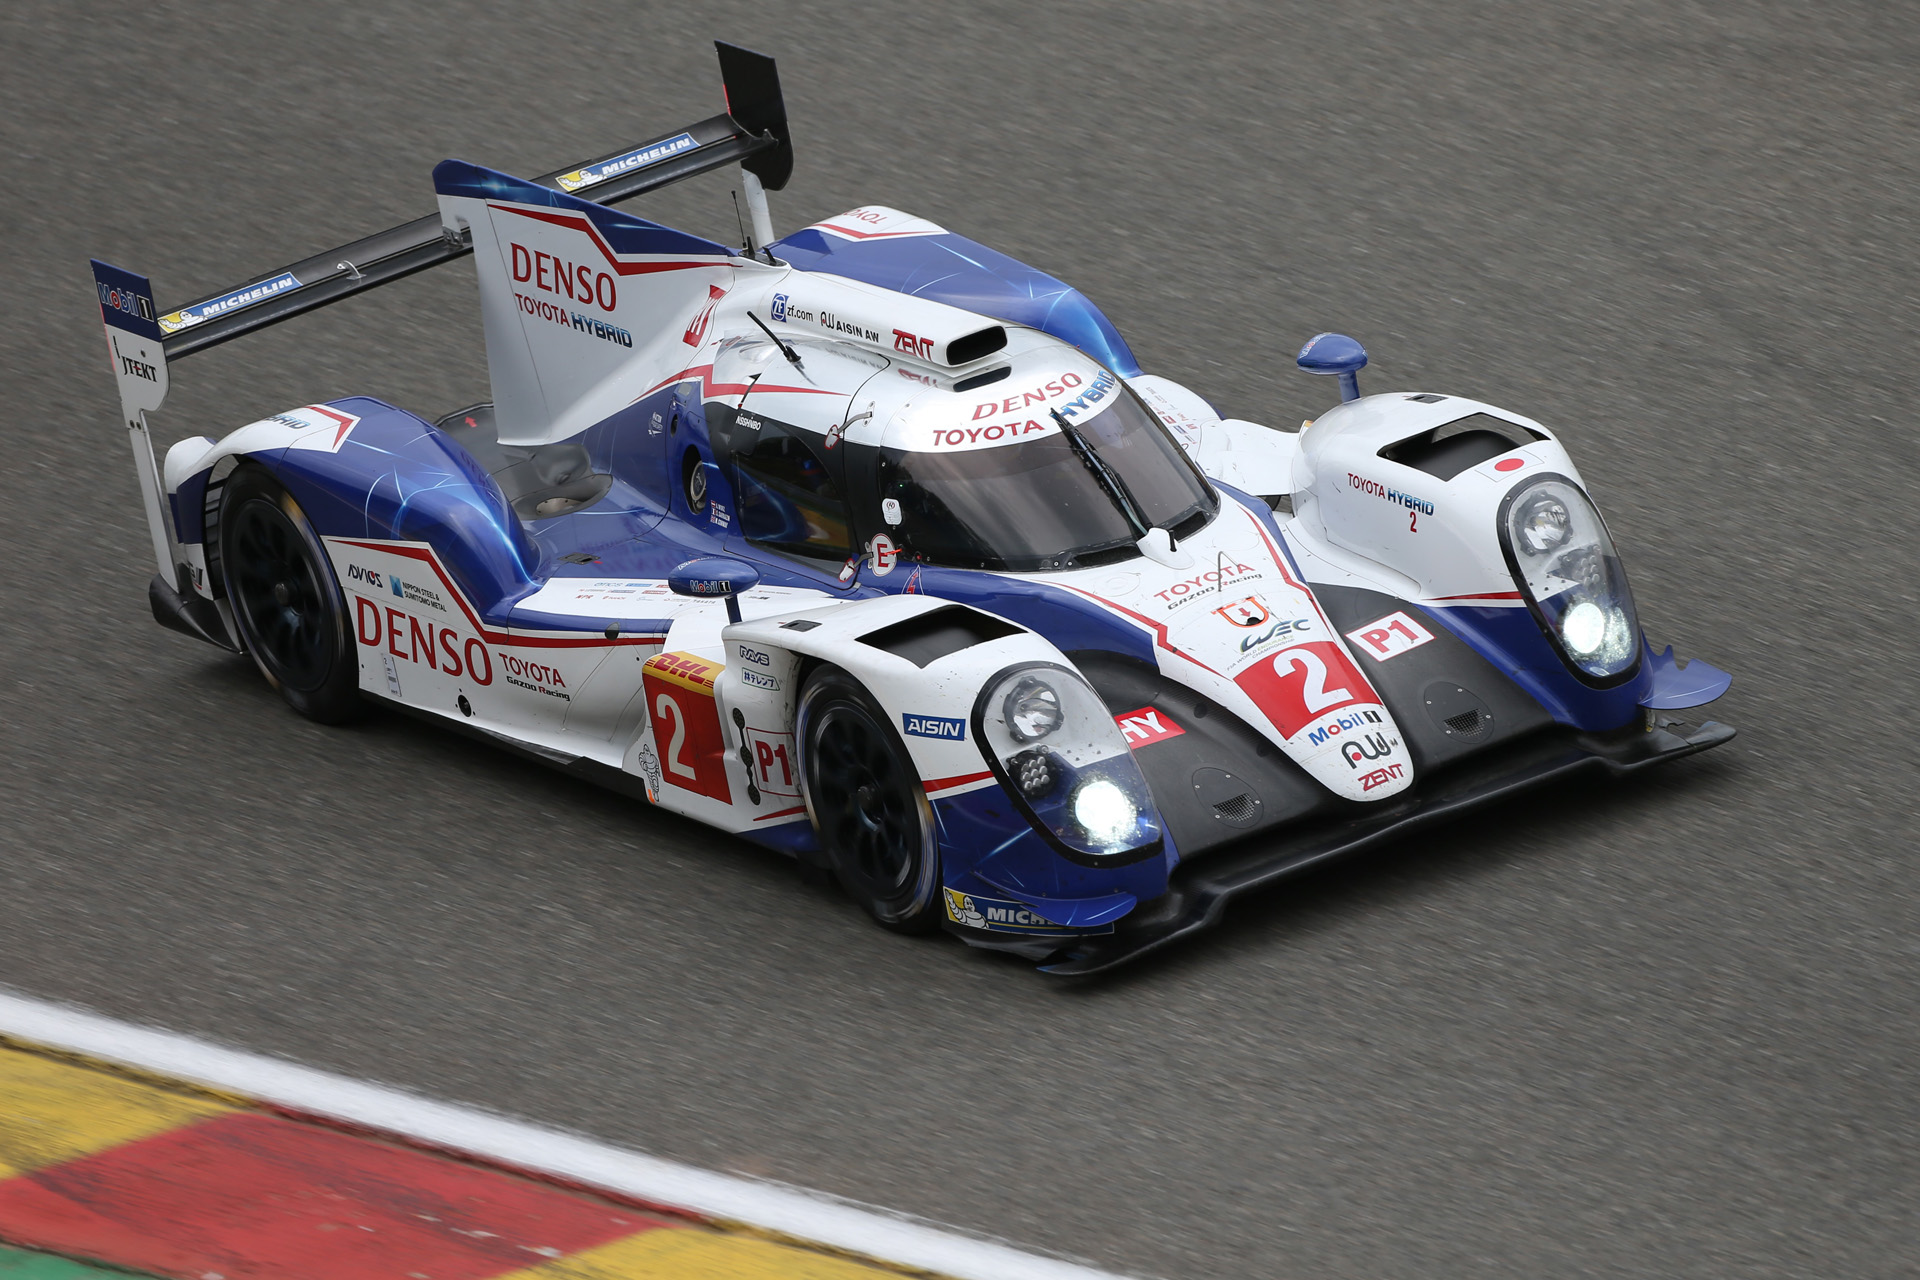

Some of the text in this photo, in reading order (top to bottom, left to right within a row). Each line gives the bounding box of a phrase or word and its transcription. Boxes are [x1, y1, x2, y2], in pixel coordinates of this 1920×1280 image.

[602, 137, 691, 175] MICHELIN
[510, 242, 616, 312] DENSO
[97, 281, 154, 322] Mobil 1
[202, 277, 293, 316] MICHELIN
[514, 292, 633, 348] TOYOTA HYBRID
[787, 305, 814, 322] zf.com
[836, 321, 863, 338] AISIN
[865, 330, 879, 343] AW
[892, 329, 934, 362] ZENT
[121, 356, 157, 383] JTEKT
[972, 372, 1082, 421] DENSO
[735, 413, 761, 431] NISSHINBO
[933, 420, 1045, 446] TOYOTA
[1347, 472, 1434, 516] TOYOTA HYBRID
[1409, 511, 1418, 533] 2
[877, 543, 890, 568] E
[402, 581, 421, 595] NIPPON
[421, 588, 436, 600] STEEL
[690, 579, 732, 594] Mobil 1
[1153, 563, 1256, 602] TOYOTA
[1167, 586, 1215, 610] GAZOO
[404, 591, 447, 612] SUMITOMO METAL
[355, 595, 493, 686] DENSO
[1240, 619, 1310, 652] WEC
[1360, 619, 1419, 653] P1
[498, 652, 566, 688] TOYOTA
[653, 653, 711, 685] DHL
[740, 645, 770, 666] RAYS
[1237, 649, 1257, 664] WORLD
[506, 675, 571, 701] GAZOO Racing
[1272, 648, 1354, 714] 2
[656, 693, 697, 781] 2
[907, 717, 960, 737] AISIN
[1120, 711, 1168, 743] HY
[1308, 711, 1383, 746] Mobil 1
[755, 740, 792, 785] P1
[1357, 763, 1404, 791] ZENT
[987, 907, 1054, 926] MICH
